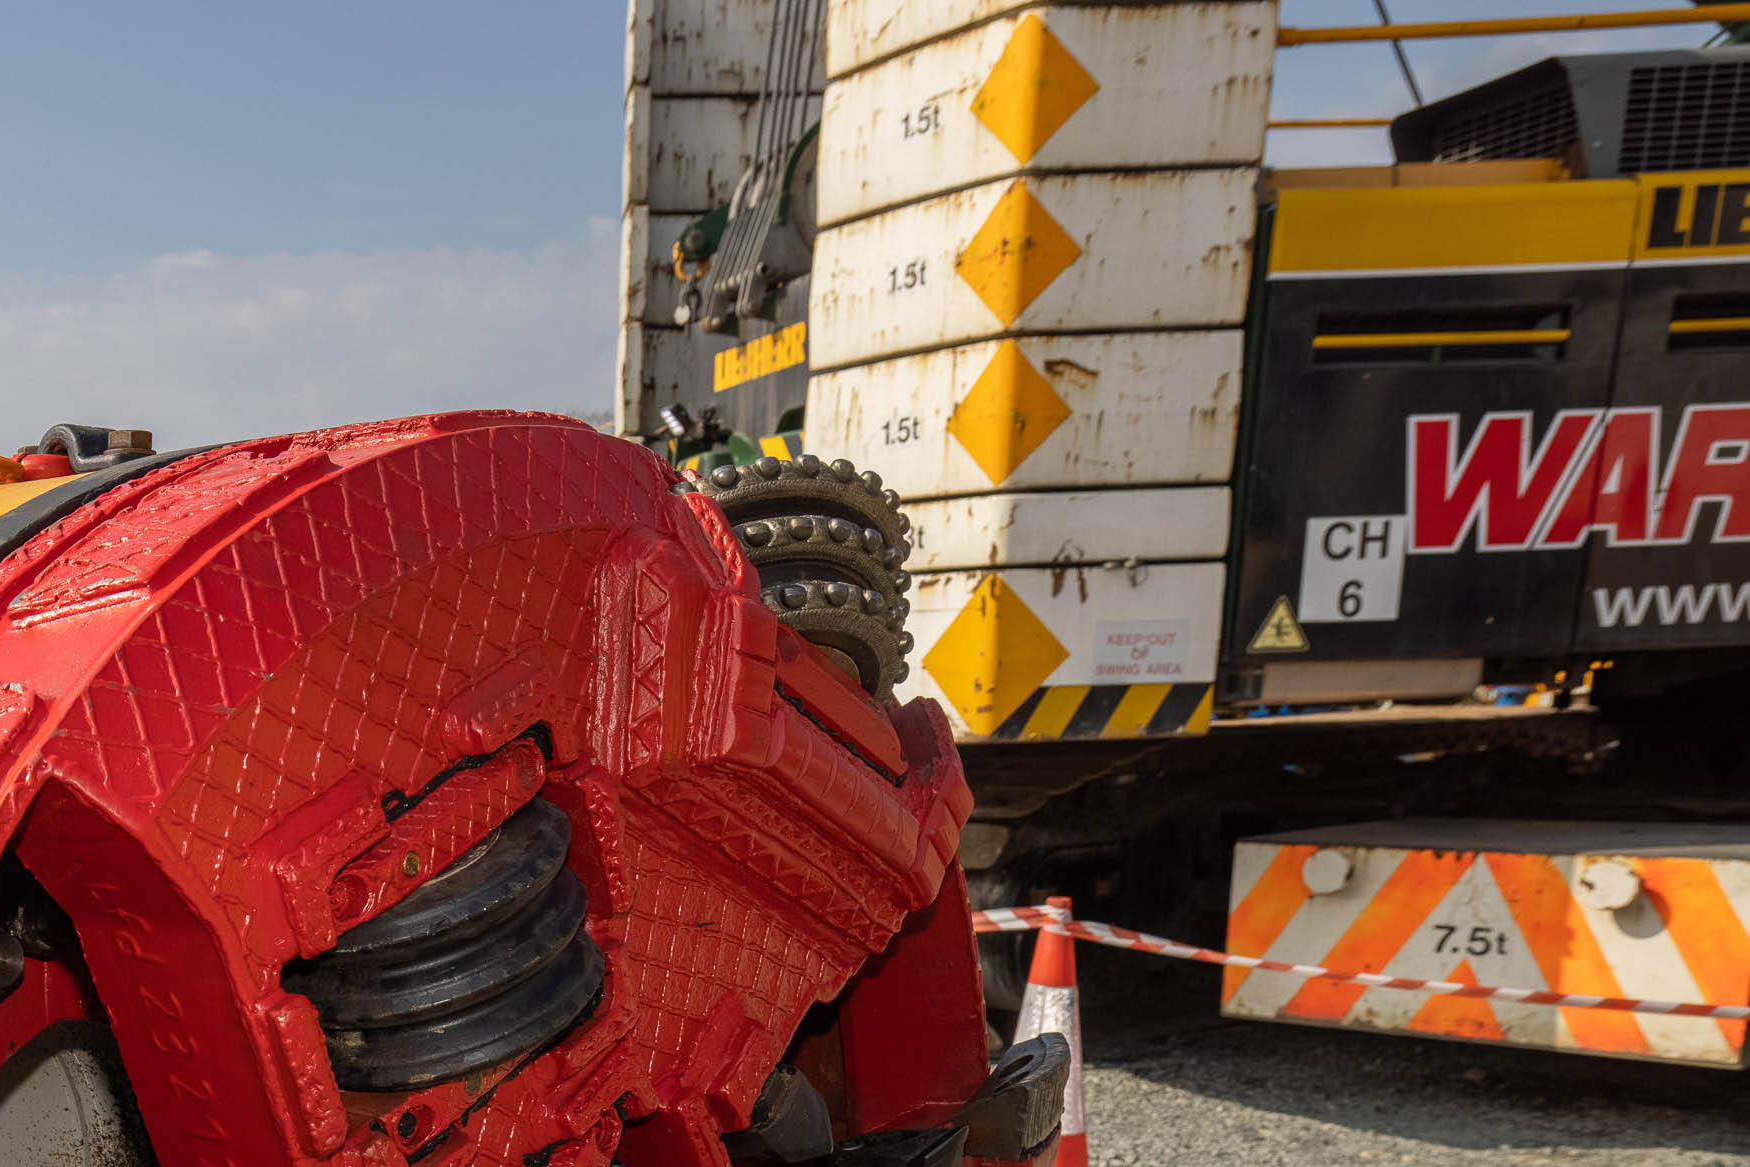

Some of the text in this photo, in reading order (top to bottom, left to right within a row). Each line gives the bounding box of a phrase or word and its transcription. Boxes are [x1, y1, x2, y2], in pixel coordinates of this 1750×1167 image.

[902, 104, 941, 139] 1.5t
[1648, 184, 1750, 248] LIE
[888, 259, 927, 295] 1.5t
[881, 415, 920, 446] 1.5t
[1406, 402, 1750, 555] WAR
[1323, 520, 1391, 560] CH
[1338, 580, 1363, 618] 6
[1144, 632, 1177, 646] OUT
[1433, 924, 1509, 956] 7.5t
